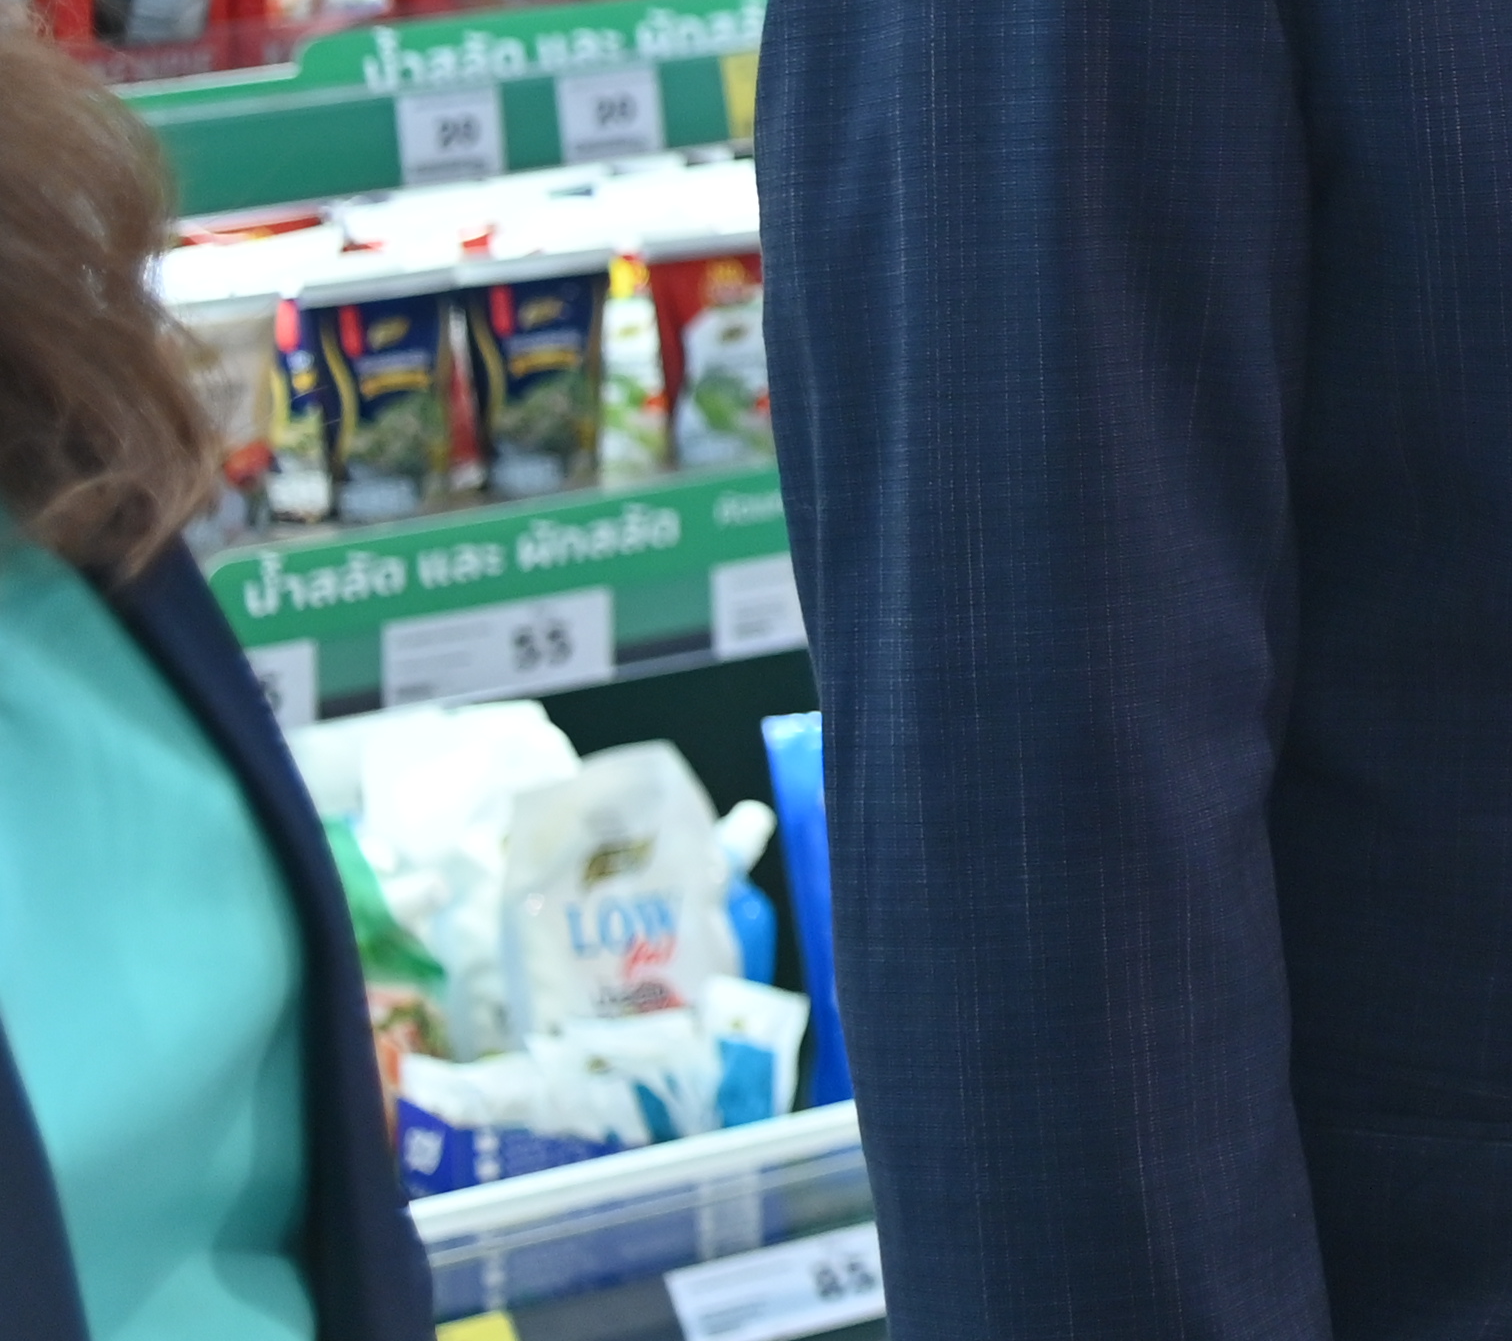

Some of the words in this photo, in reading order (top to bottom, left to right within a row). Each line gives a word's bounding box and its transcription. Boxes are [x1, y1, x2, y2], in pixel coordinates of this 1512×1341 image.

[362, 25, 526, 91] น้ำสลัด
[536, 27, 627, 72] และ
[243, 550, 407, 619] น้ำสลัด
[416, 540, 506, 589] และ
[514, 502, 682, 573] ผักสลัด
[566, 889, 684, 960] LOW
